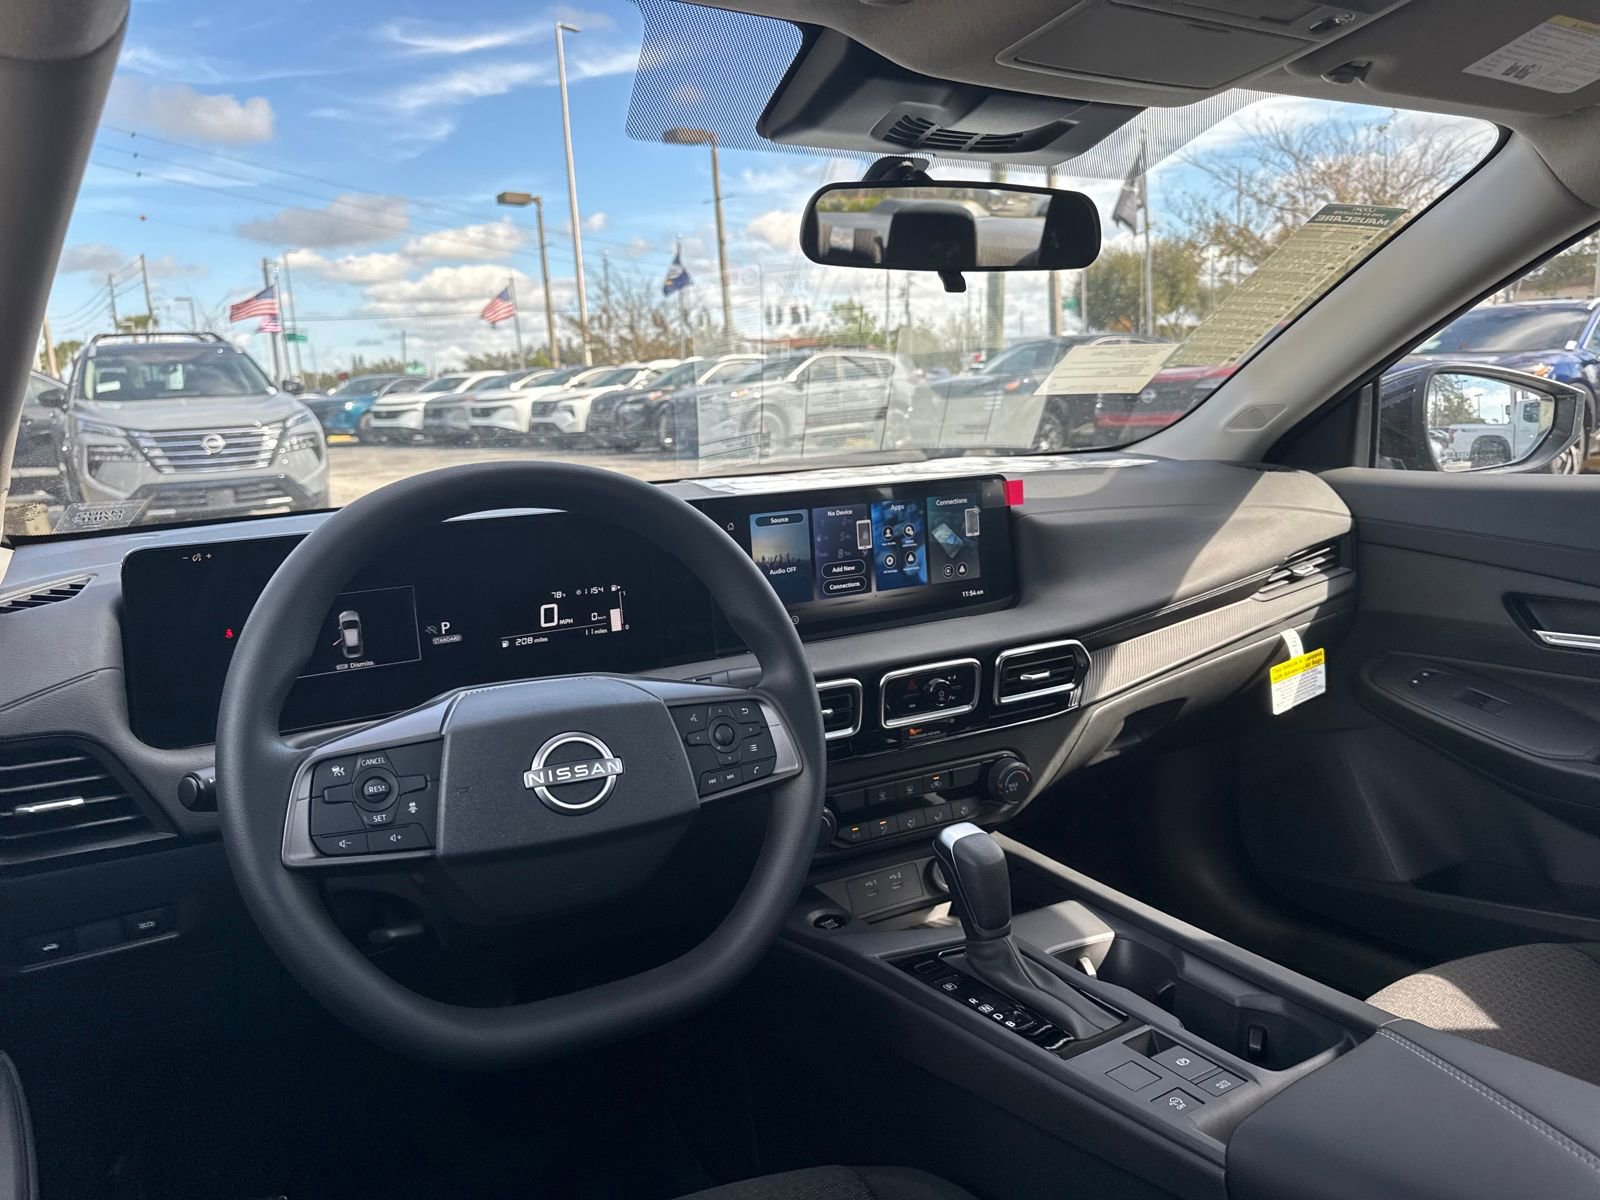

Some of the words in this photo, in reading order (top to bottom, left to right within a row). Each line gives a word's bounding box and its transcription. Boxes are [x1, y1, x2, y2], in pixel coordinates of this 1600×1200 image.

[936, 498, 968, 506] Connections
[770, 516, 789, 524] Source
[769, 567, 786, 575] Audio
[786, 566, 797, 574] OFF
[829, 581, 861, 590] Connections
[540, 603, 558, 627] 0
[559, 617, 574, 625] MPH
[591, 612, 598, 620] 0
[441, 621, 451, 634] P
[433, 635, 462, 643] STANDARD
[515, 637, 534, 646] 208
[350, 660, 375, 669] Dismiss
[361, 756, 385, 767] CANCEL
[527, 761, 621, 786] NISSAN
[372, 814, 387, 823] SET
[968, 997, 979, 1005] R
[992, 1012, 1004, 1021] D
[1005, 1020, 1016, 1028] B
